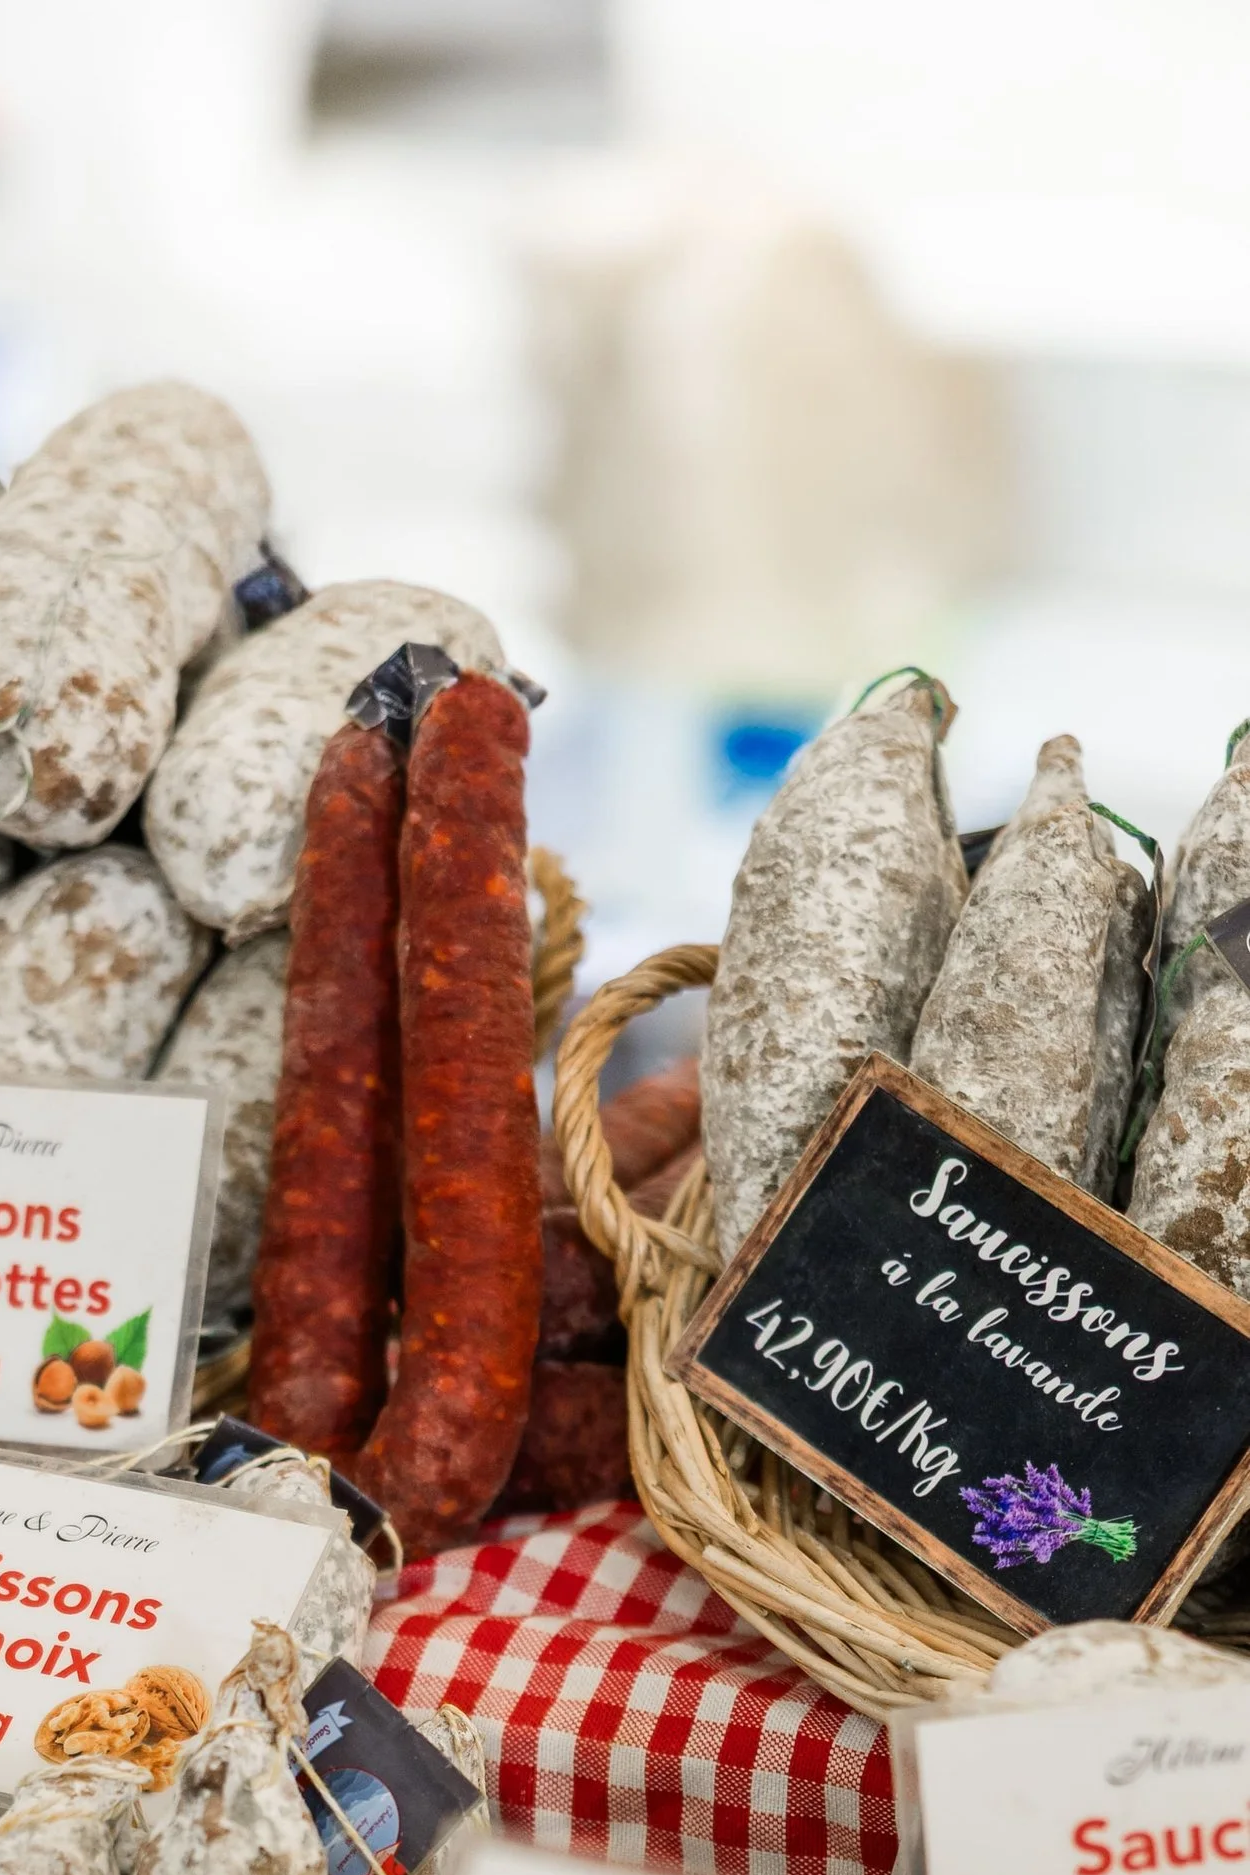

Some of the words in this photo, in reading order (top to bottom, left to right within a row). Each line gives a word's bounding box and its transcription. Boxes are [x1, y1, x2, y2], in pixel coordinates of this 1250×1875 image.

[910, 1158, 1185, 1381] Saucissons
[915, 1272, 963, 1323] la
[966, 1307, 1123, 1432] lavande
[746, 1299, 962, 1498] 42,90€/Kg
[23, 1511, 49, 1533] &
[55, 1513, 161, 1554] Pierre
